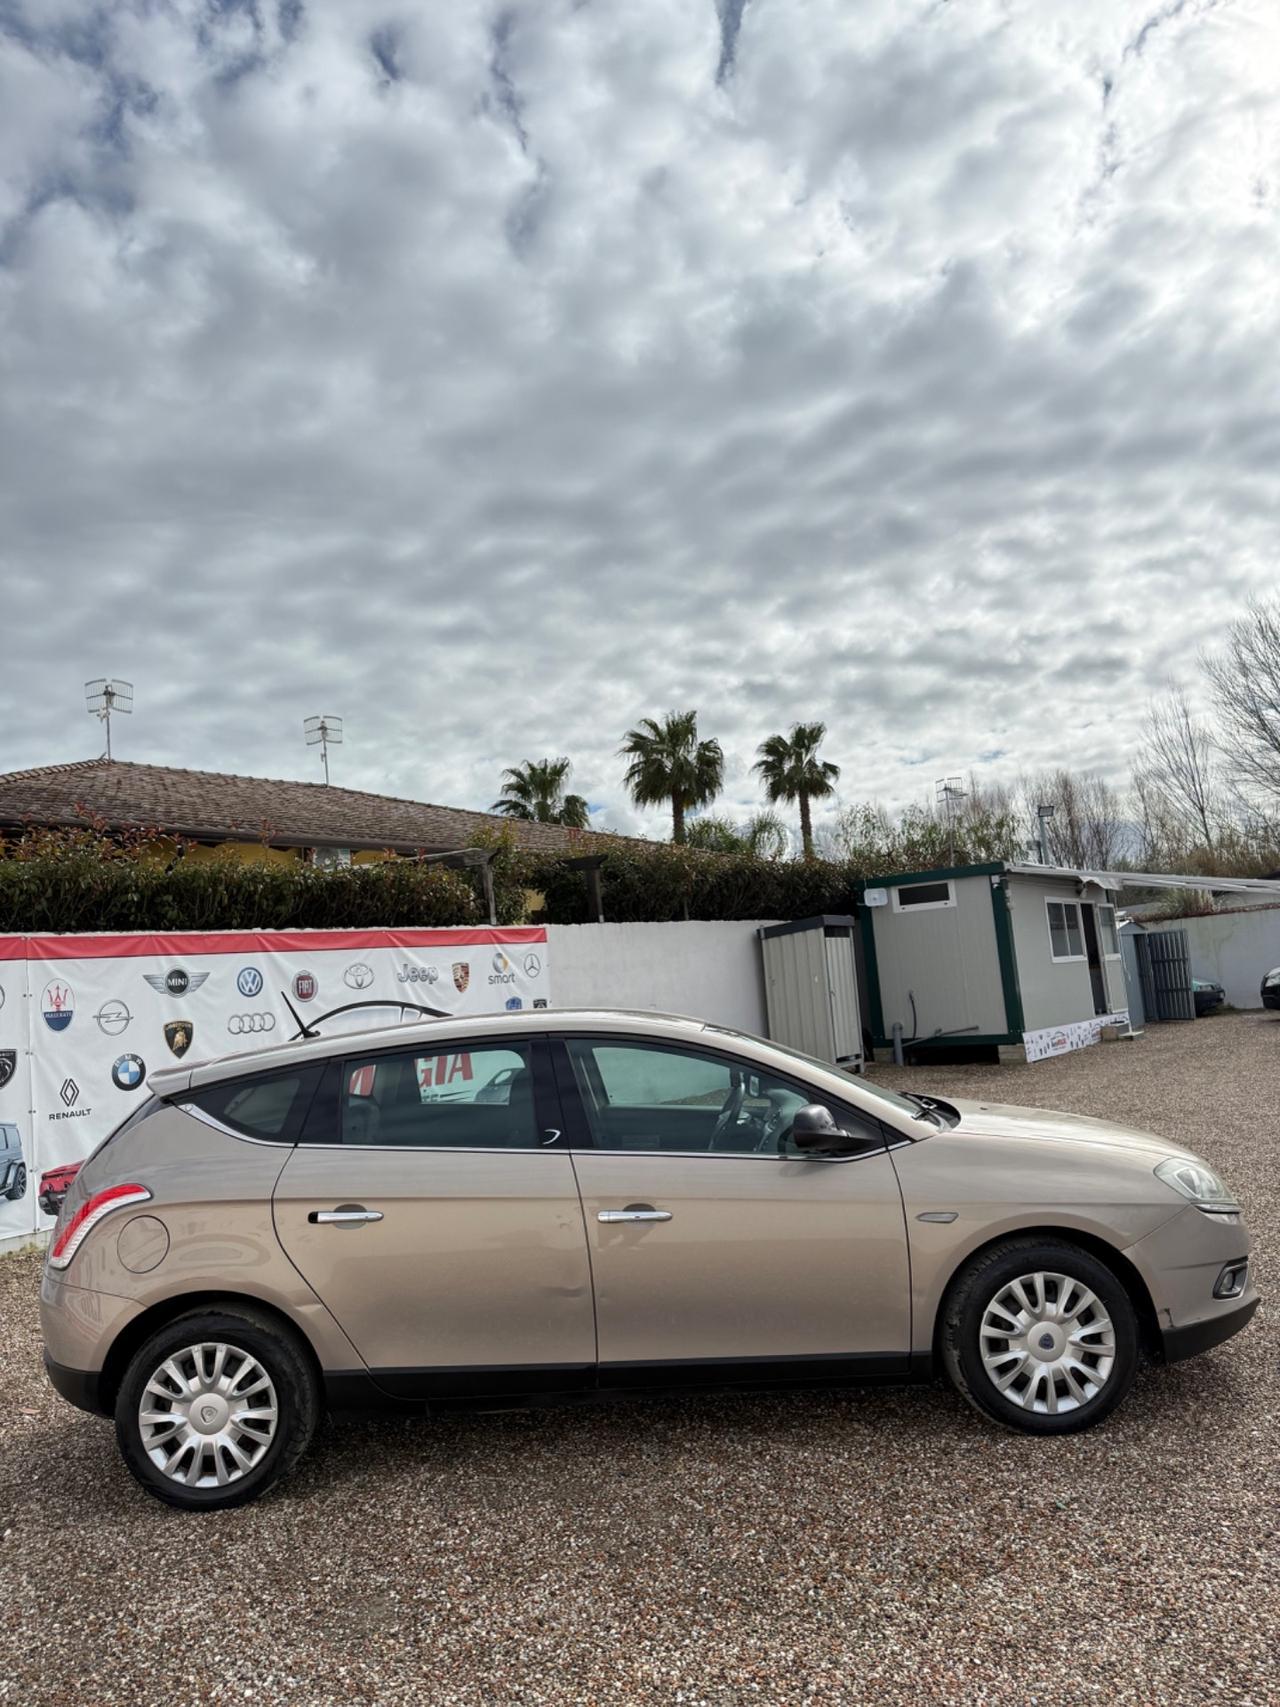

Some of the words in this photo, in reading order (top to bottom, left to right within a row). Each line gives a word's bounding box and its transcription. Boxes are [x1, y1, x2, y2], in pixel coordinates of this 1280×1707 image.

[397, 963, 439, 985] Jeep
[488, 973, 515, 984] smart
[167, 978, 188, 986] MINI
[298, 979, 313, 994] FIAT
[48, 1108, 92, 1120] RENAULT
